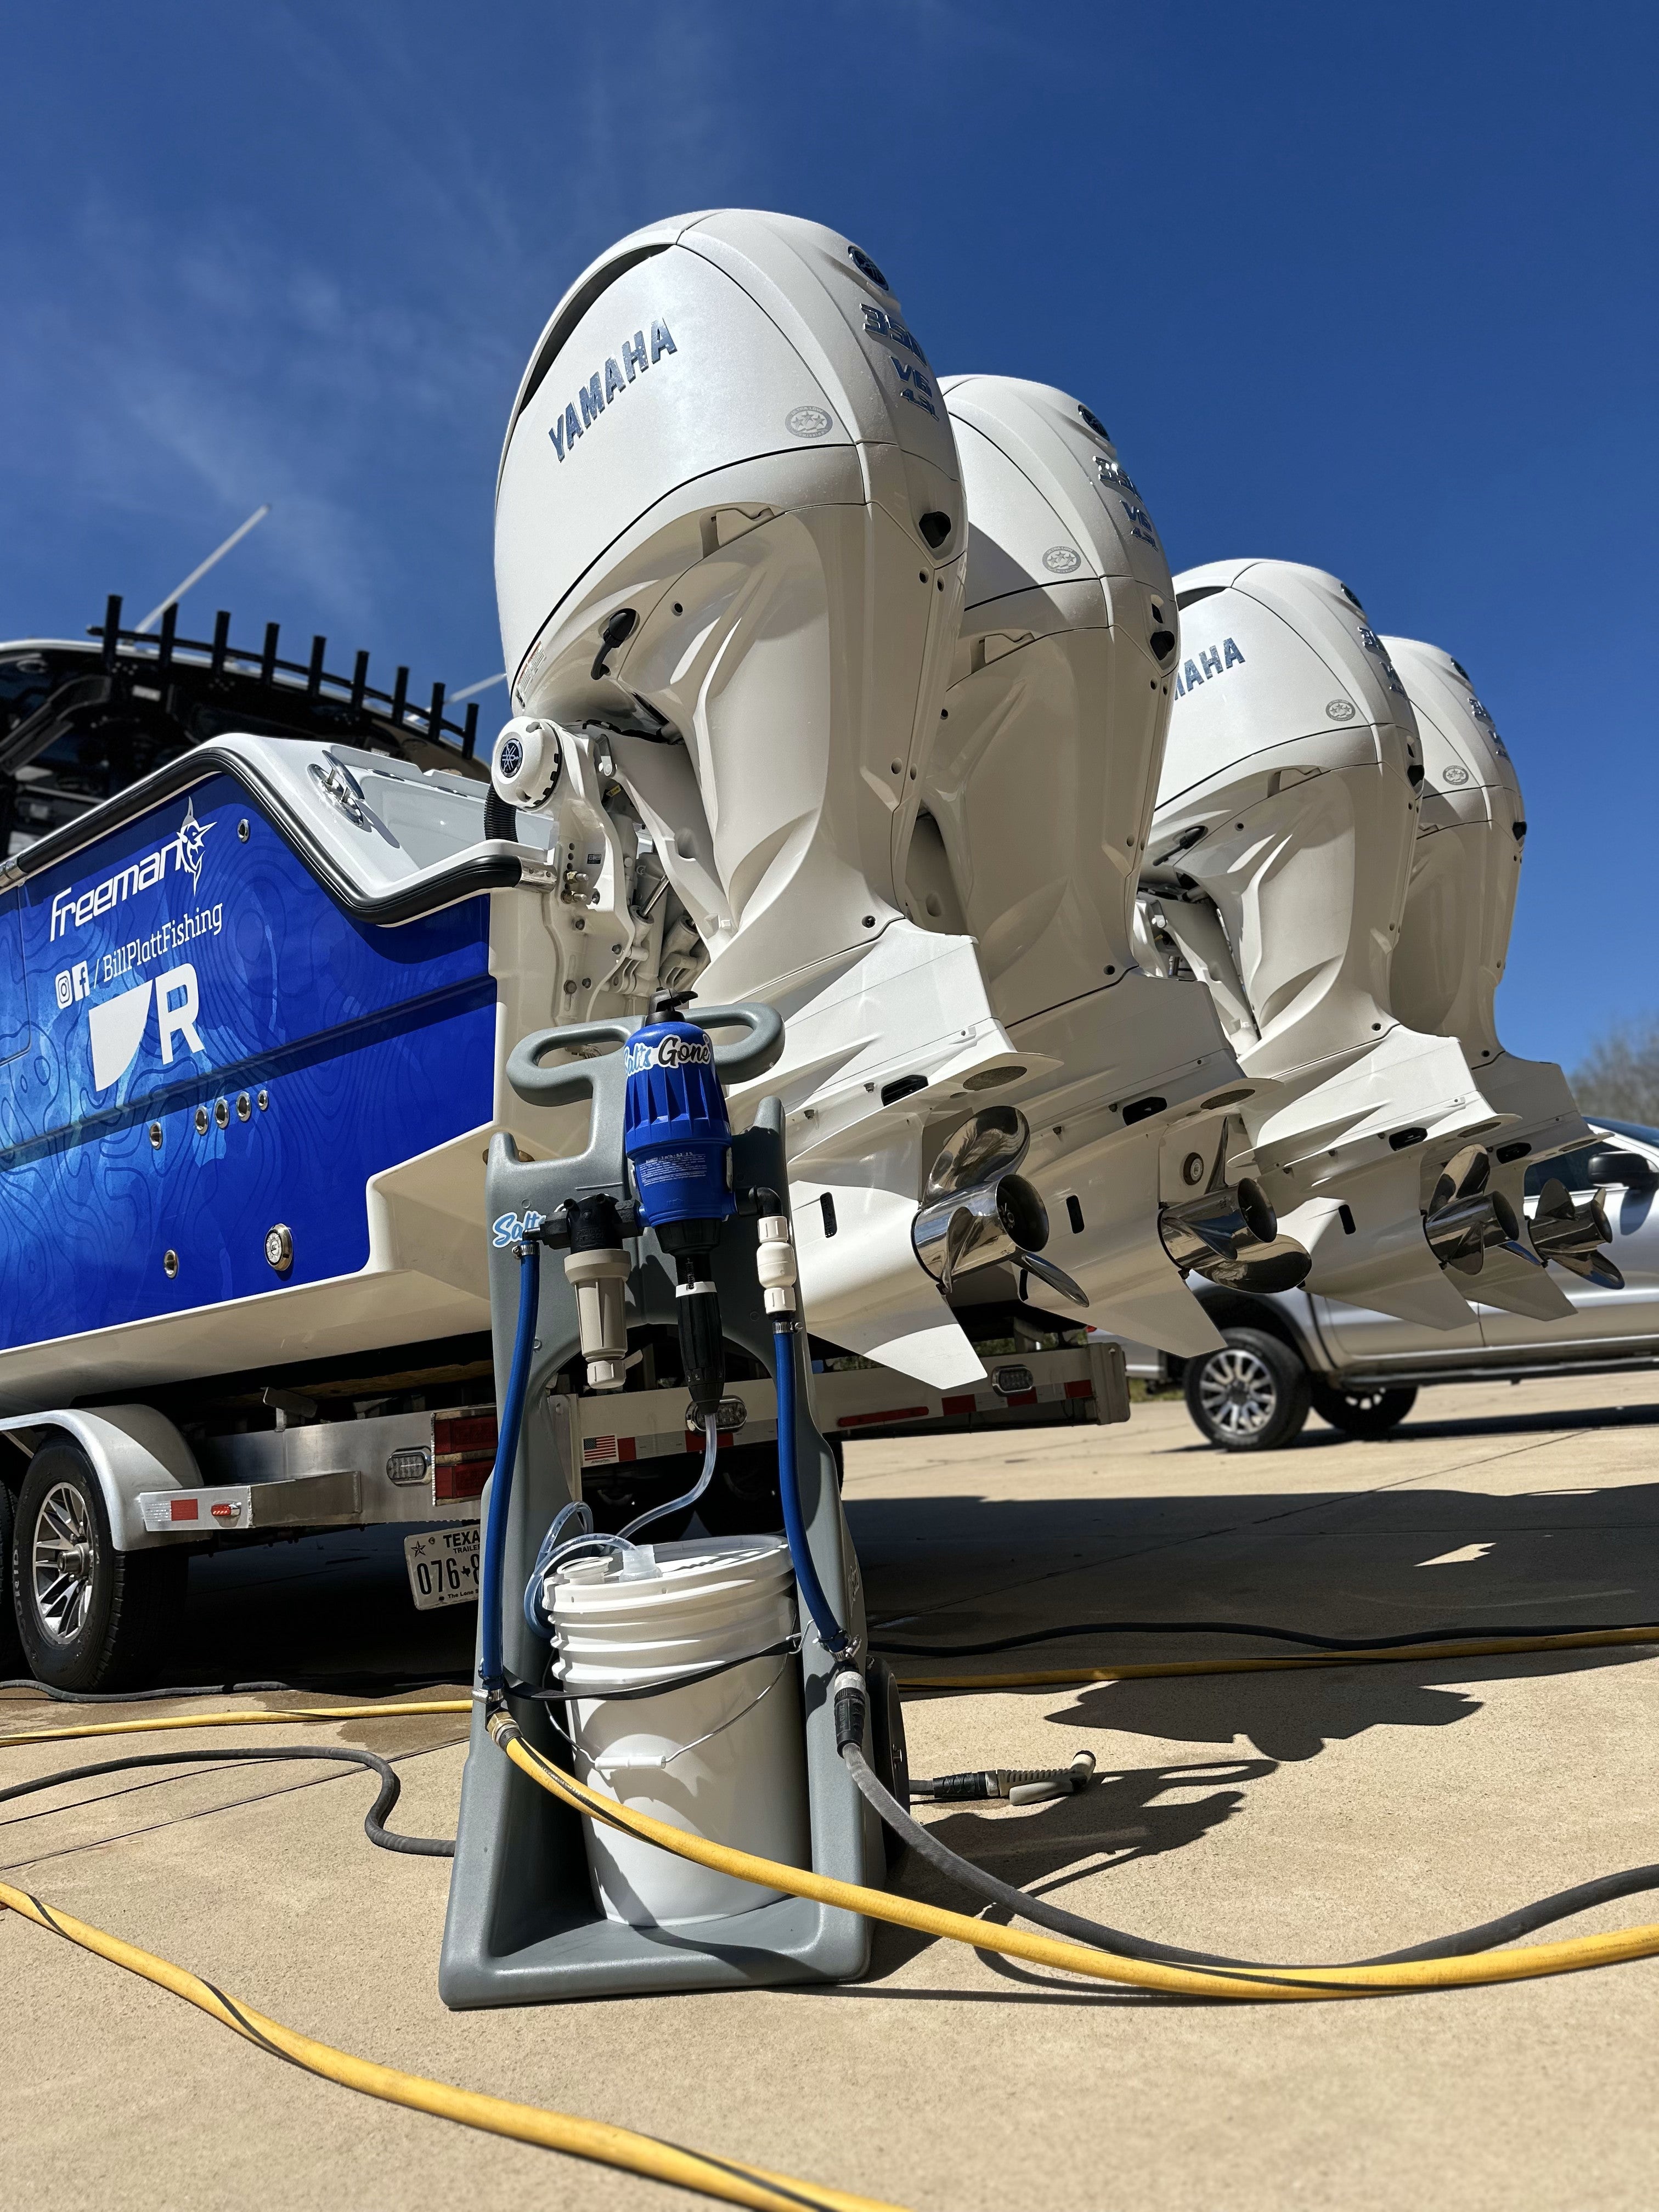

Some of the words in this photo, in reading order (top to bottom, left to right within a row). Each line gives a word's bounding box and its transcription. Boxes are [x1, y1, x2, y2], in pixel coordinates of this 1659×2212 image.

[549, 317, 678, 463] YAMAHA
[889, 356, 932, 398] V6
[1175, 637, 1245, 701] AHA
[658, 1037, 710, 1066] Gone
[443, 1530, 480, 1548] TEXA
